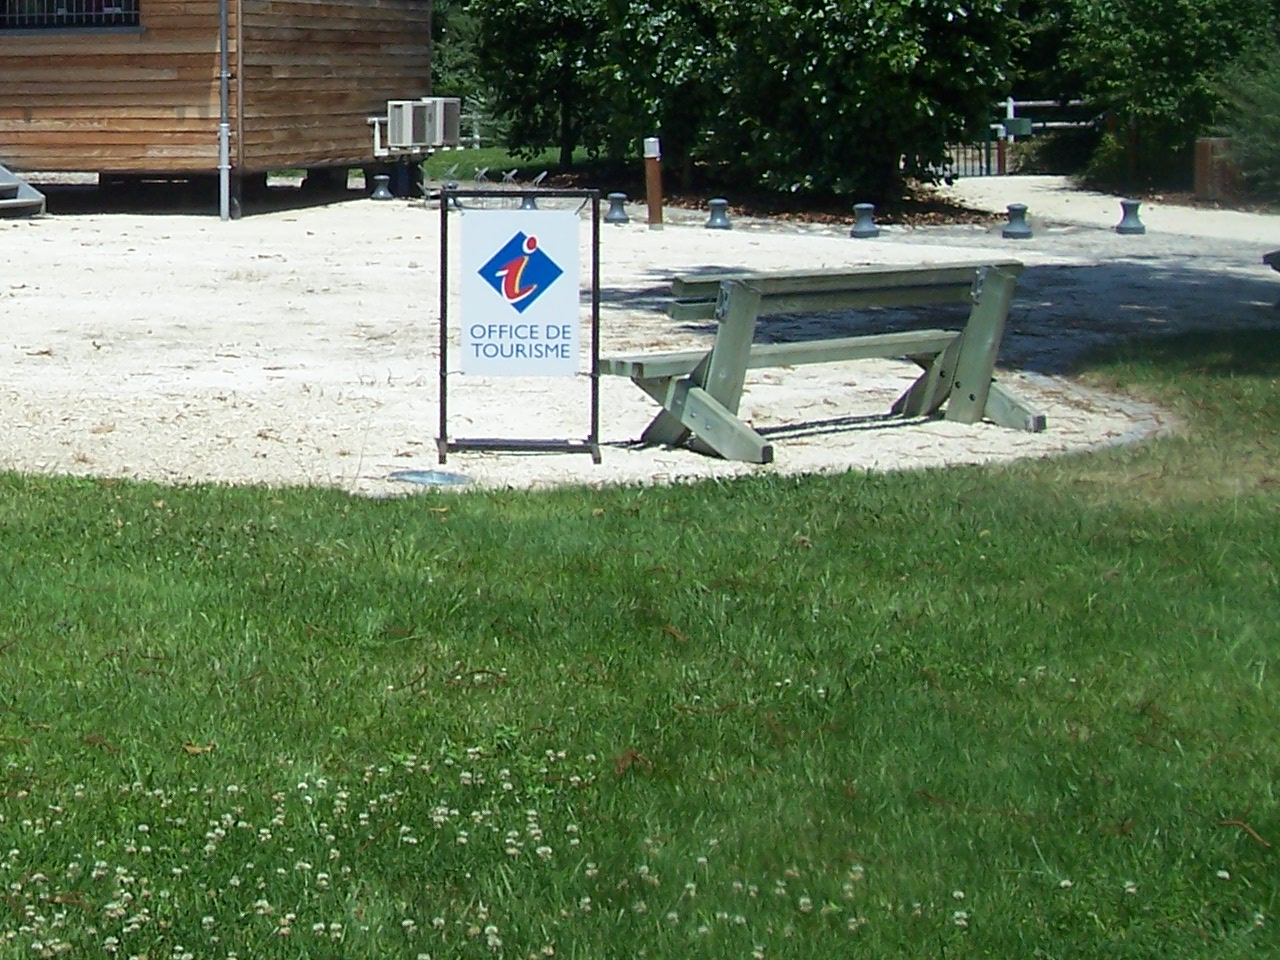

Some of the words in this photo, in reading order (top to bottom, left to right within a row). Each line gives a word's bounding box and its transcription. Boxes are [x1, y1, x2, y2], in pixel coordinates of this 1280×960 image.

[470, 324, 539, 339] OFFICE
[546, 324, 571, 339] DE
[471, 343, 570, 358] TOURISME
